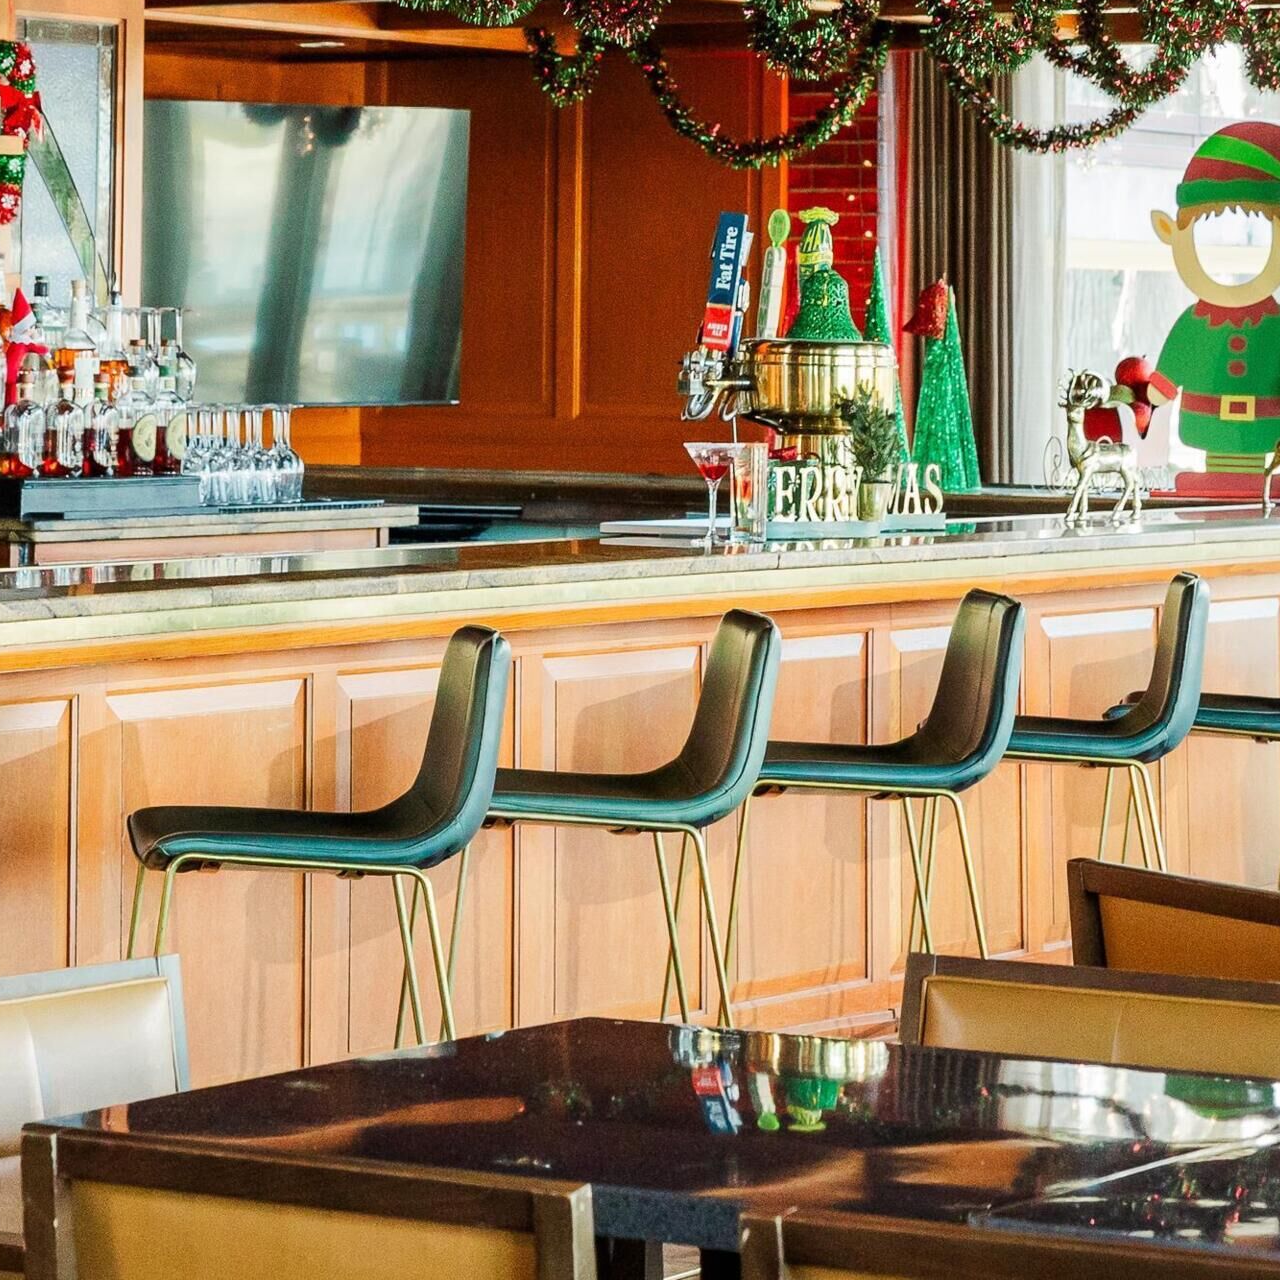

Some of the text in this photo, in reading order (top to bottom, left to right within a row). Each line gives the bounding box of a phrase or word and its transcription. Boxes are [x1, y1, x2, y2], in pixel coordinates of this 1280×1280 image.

[715, 226, 738, 291] Fat Tire
[773, 465, 863, 521] ERRY
